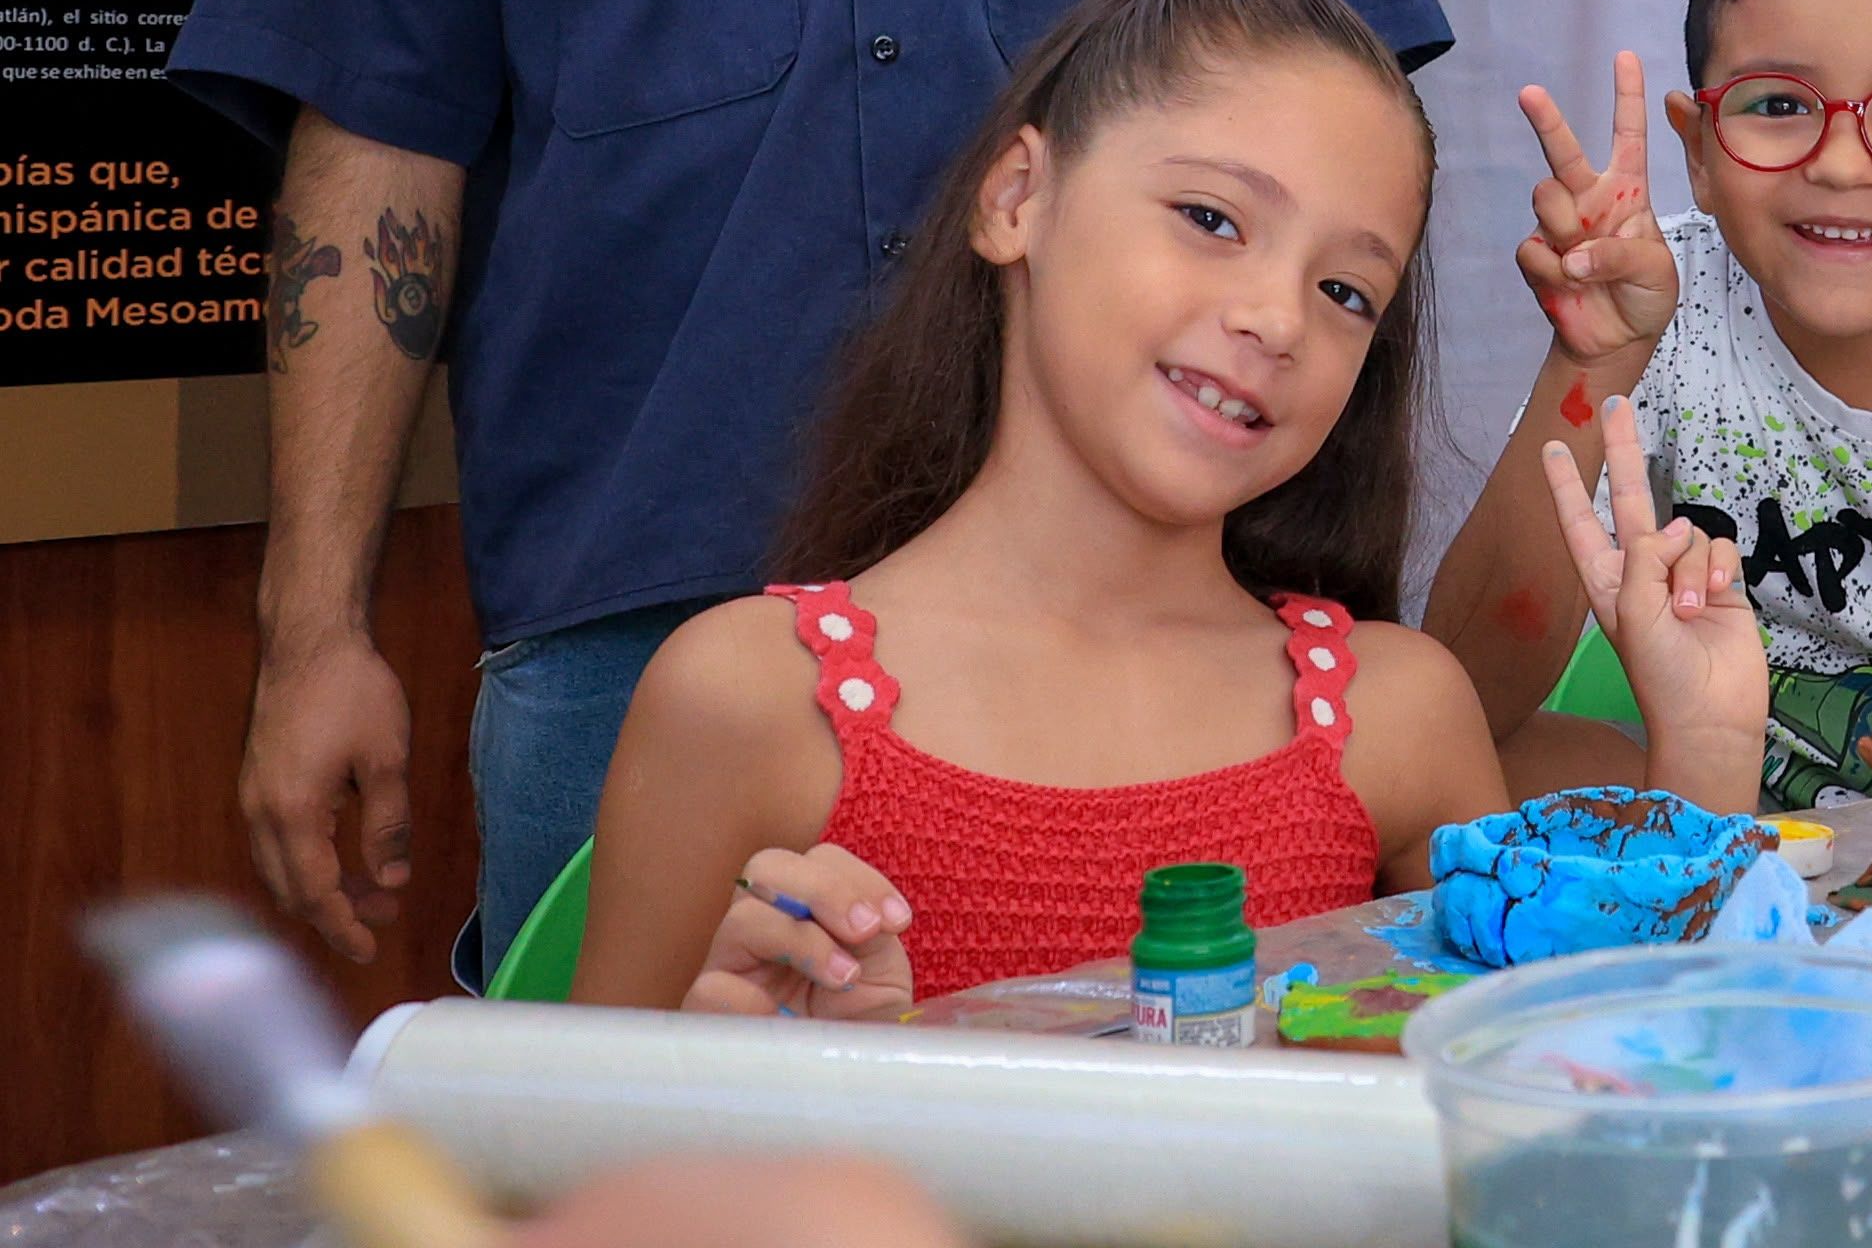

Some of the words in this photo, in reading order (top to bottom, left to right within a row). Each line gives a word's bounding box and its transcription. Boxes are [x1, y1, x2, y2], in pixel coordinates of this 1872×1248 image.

[89, 9, 128, 25] sitio
[2, 66, 38, 82] que
[62, 63, 123, 79] exhibe
[89, 160, 179, 190] que,
[206, 199, 258, 229] de
[24, 247, 182, 282] calidad
